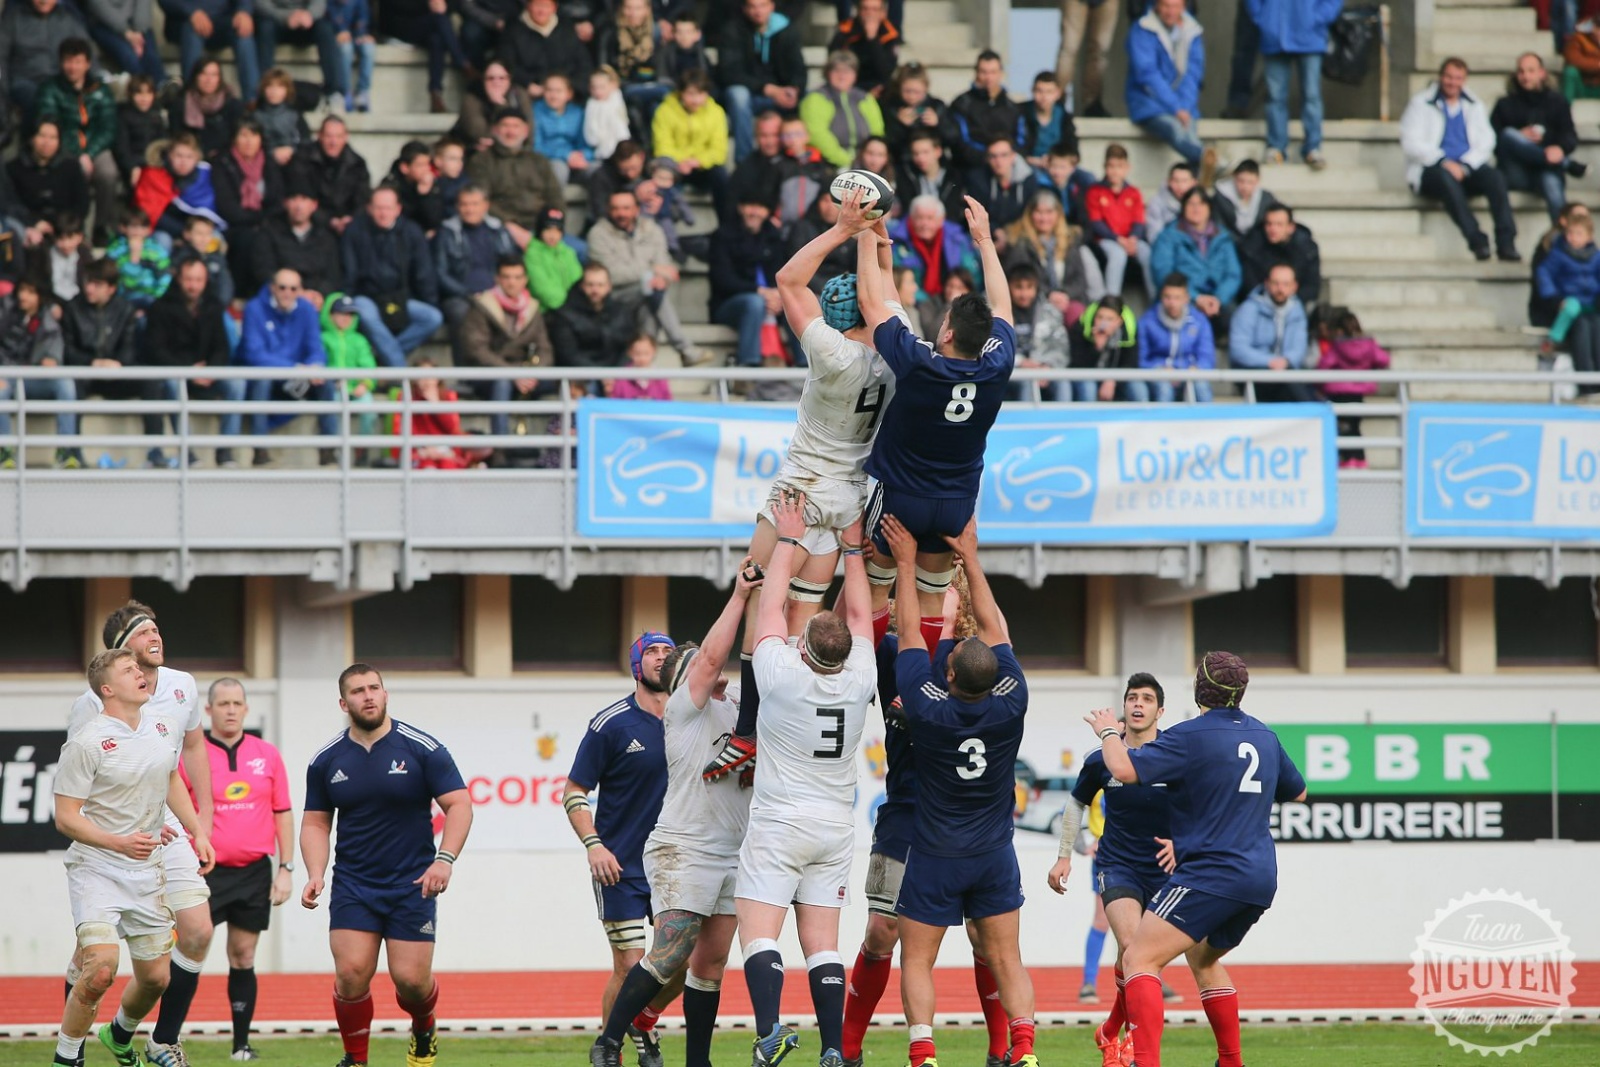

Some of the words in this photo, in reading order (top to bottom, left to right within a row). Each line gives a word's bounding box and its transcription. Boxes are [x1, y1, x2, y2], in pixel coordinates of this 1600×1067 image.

[854, 383, 887, 429] 4
[944, 382, 978, 423] 8
[1116, 435, 1309, 484] Loir&Cher
[1115, 488, 1140, 511] LE
[1148, 486, 1309, 511] DÉPARTEMENT
[813, 708, 845, 758] 3
[956, 738, 987, 780] 3
[1237, 742, 1262, 793] 2
